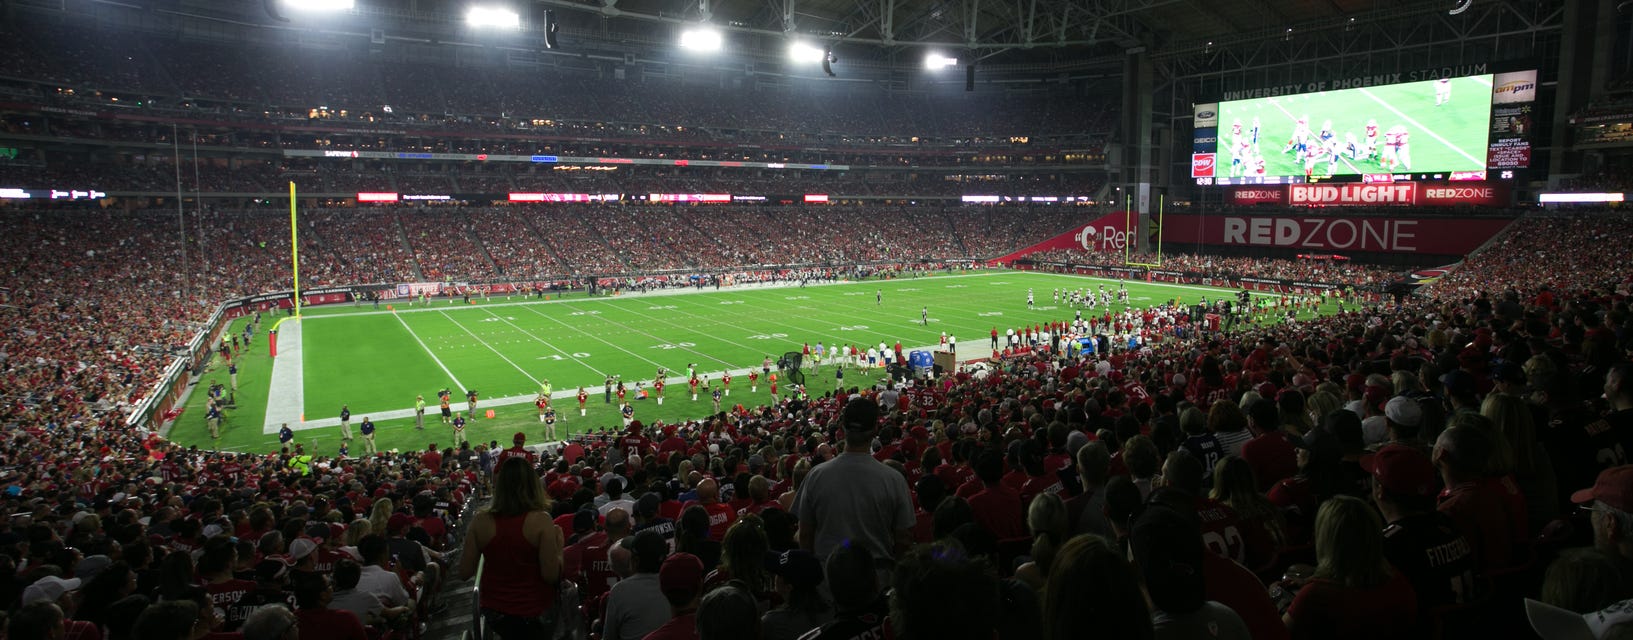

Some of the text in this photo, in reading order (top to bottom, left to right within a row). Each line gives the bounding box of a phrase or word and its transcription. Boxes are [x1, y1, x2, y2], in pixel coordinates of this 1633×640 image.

[1223, 63, 1488, 101] UNIVERSITY OF PHOENIX STADIUM
[1495, 82, 1534, 94] ampm
[1235, 190, 1281, 199] REDZONE
[1293, 185, 1410, 202] BUD LIGHT
[1426, 187, 1495, 198] REDZONE
[1103, 225, 1137, 249] Red
[1224, 217, 1417, 251] REDZONE
[922, 395, 934, 406] 32
[627, 446, 639, 456] 21
